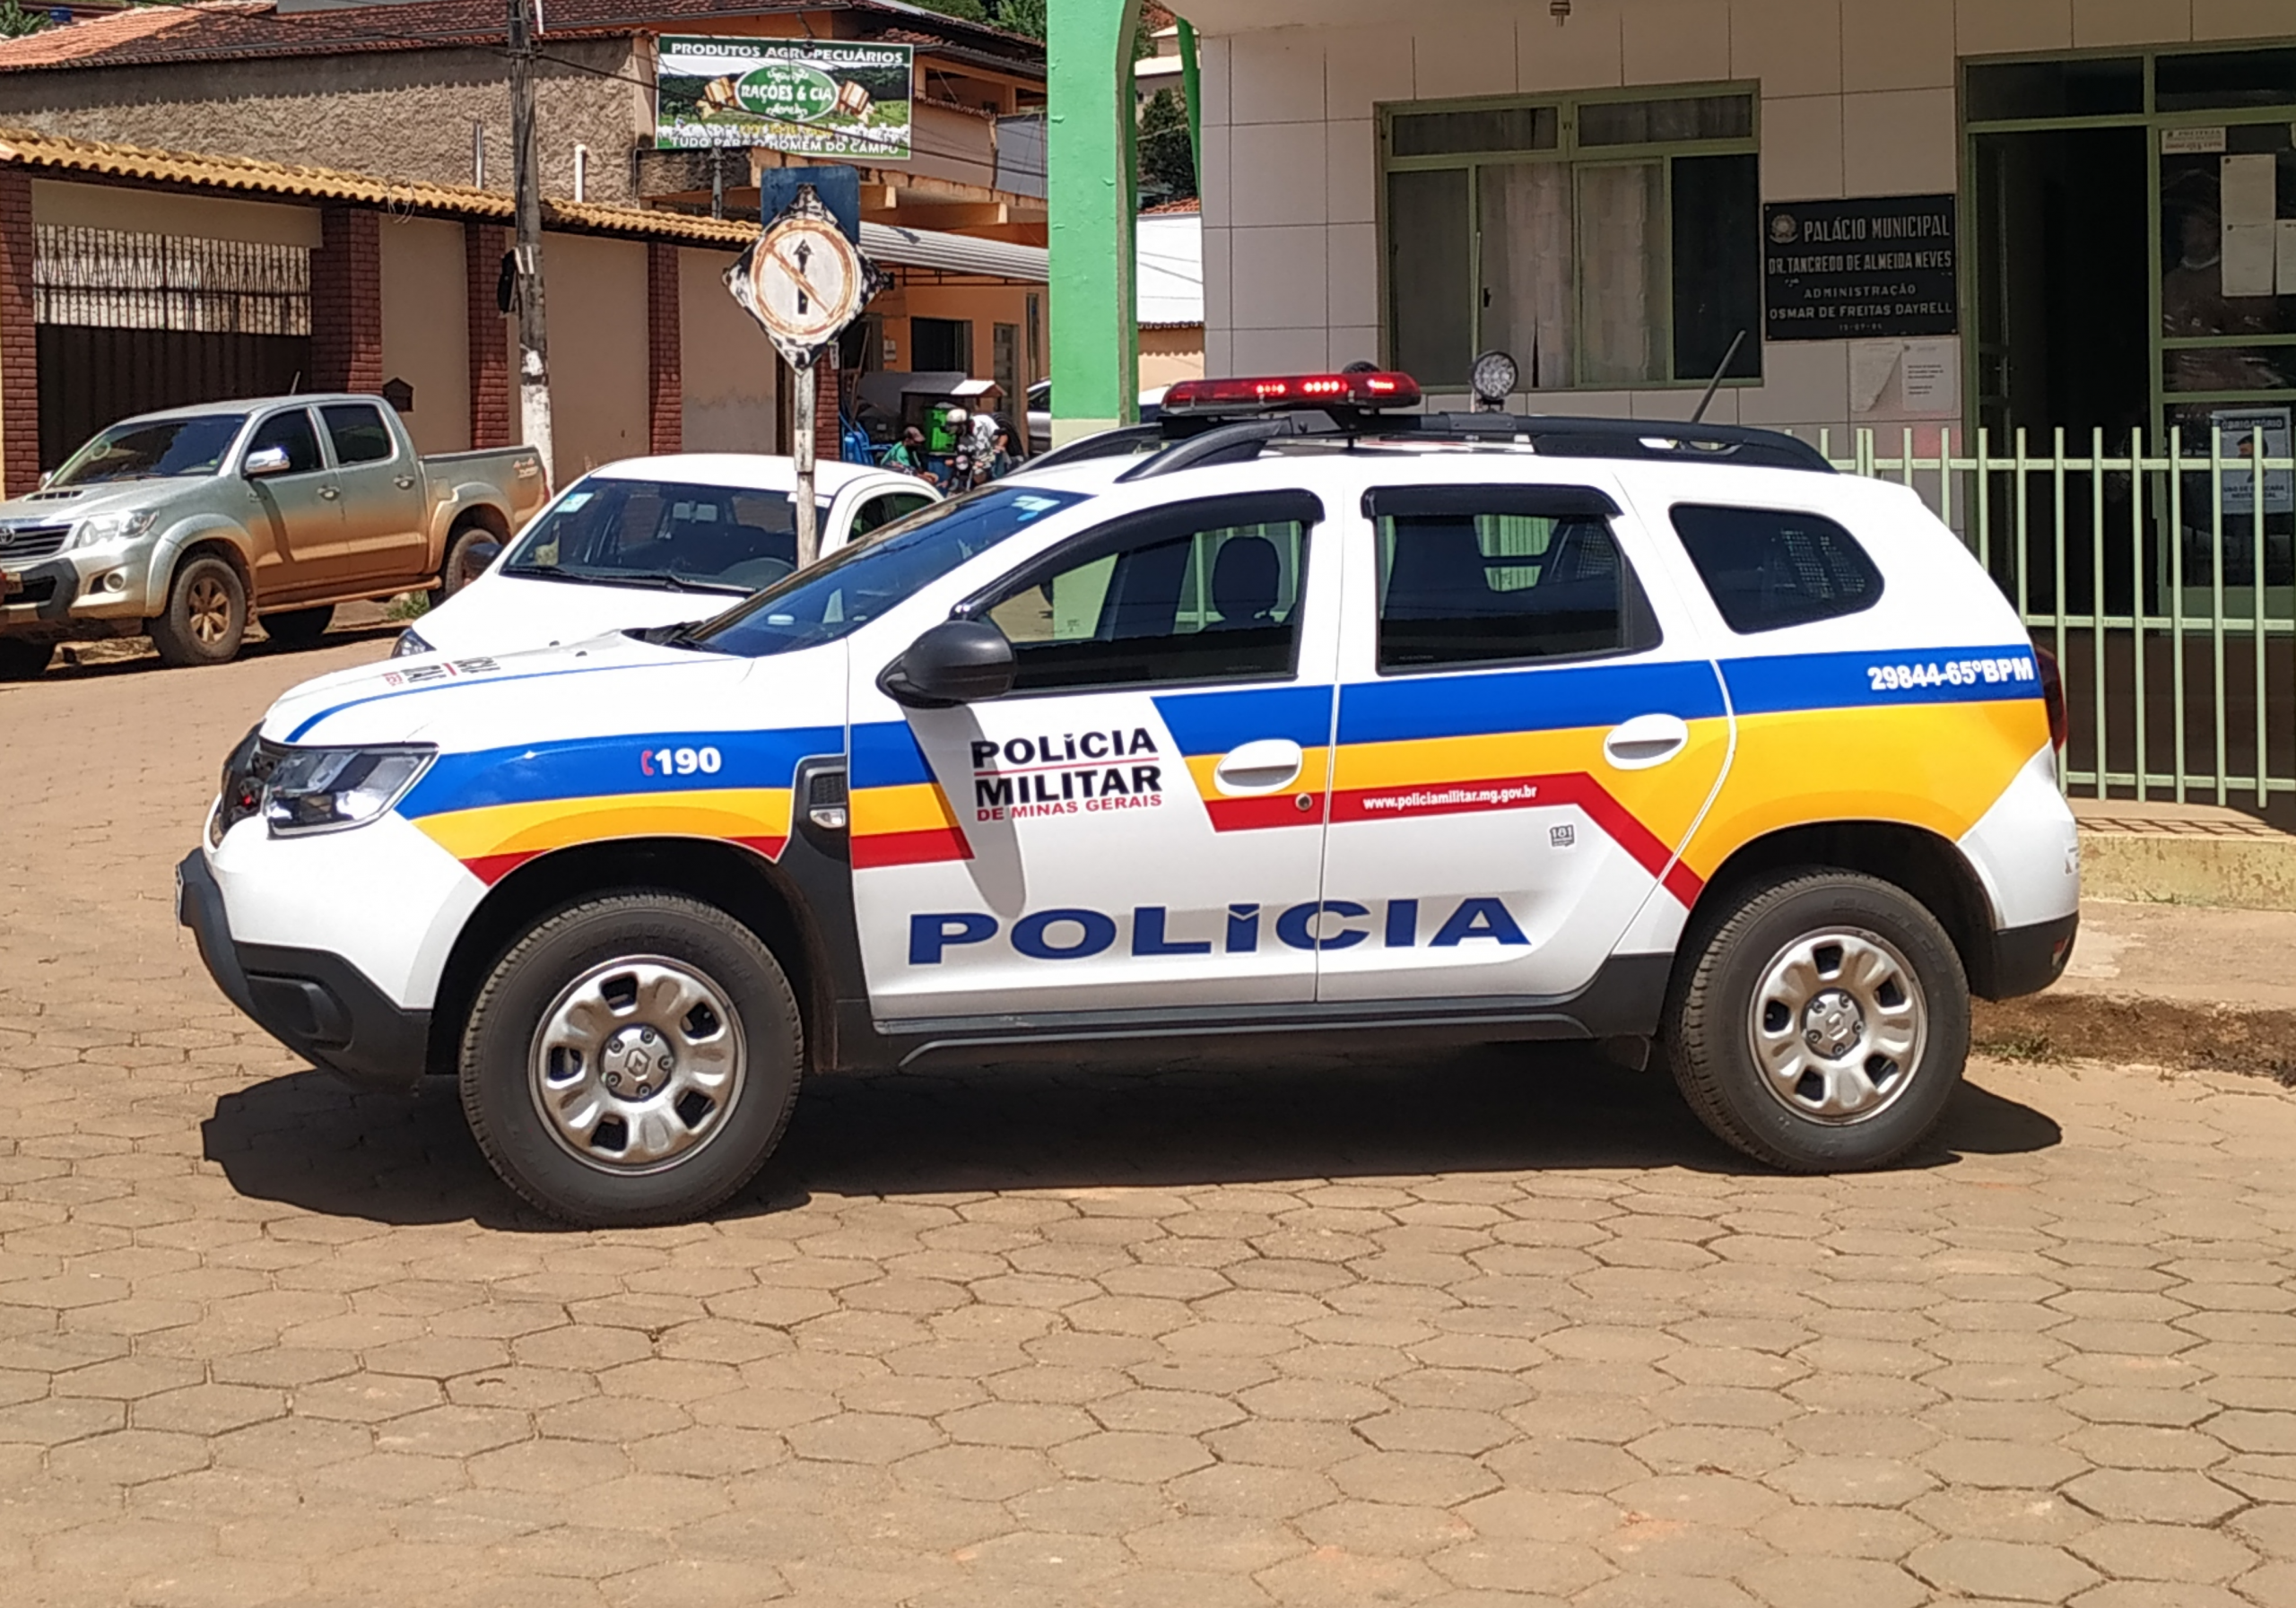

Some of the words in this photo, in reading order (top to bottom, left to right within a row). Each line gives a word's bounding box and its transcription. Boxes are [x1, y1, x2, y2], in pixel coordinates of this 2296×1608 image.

[672, 42, 761, 57] PRODUTOS
[764, 46, 903, 63] AGROPECUÁRIOS
[741, 83, 793, 102] RAÇÕES
[796, 85, 807, 101] &
[810, 84, 833, 101] CIA
[672, 137, 709, 148] TUDO
[754, 139, 765, 147] O
[769, 138, 822, 151] HOMEM
[825, 142, 845, 152] DO
[850, 143, 899, 154] CAMPO
[1804, 217, 1866, 242] PALÁCIO
[1872, 214, 1950, 239] MUNICIPAL
[1769, 257, 1787, 274] DR.
[1787, 255, 1844, 274] TANCREDO
[1847, 255, 1861, 271] DE
[1864, 252, 1912, 270] ALMEIDA
[1915, 250, 1952, 268] NEVES
[1804, 283, 1916, 299] ADMINISTRAÇÃO
[1770, 307, 1814, 320] OSMAR
[1818, 306, 1836, 318] DE
[1839, 305, 1891, 317] FREITAS
[1896, 302, 1952, 316] DAYRELL
[655, 747, 721, 775] 190
[975, 765, 1162, 807] MILITAR
[1363, 785, 1536, 811] www.policiamilitar.mg.gov.br
[977, 808, 1004, 821] DE
[1012, 800, 1078, 819] MINAS
[1085, 795, 1162, 812] GERAIS
